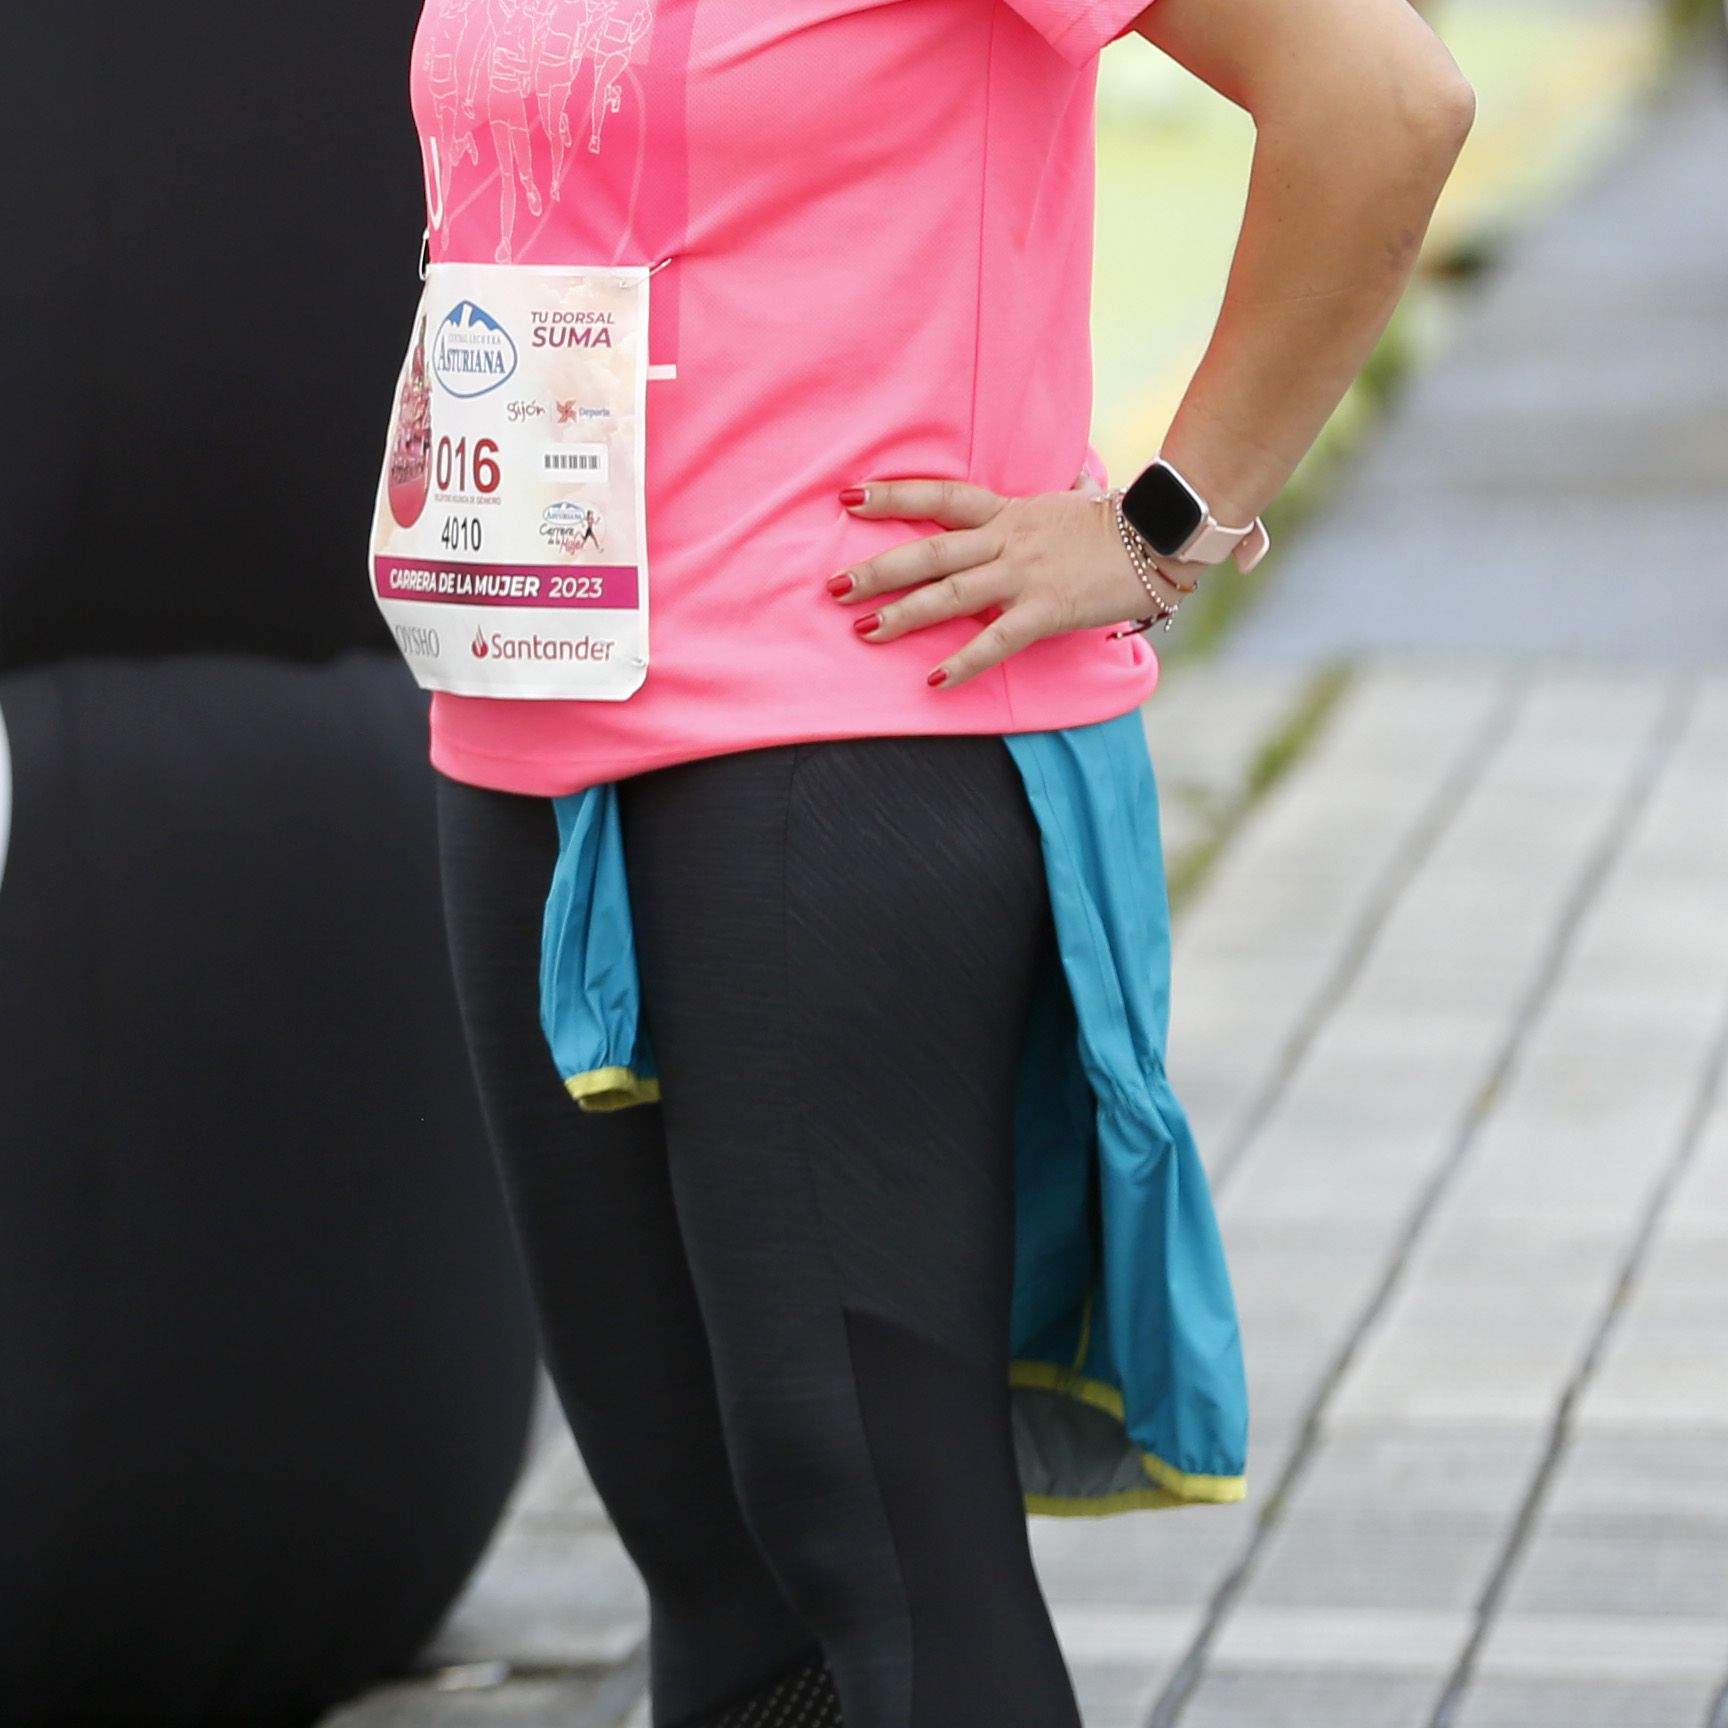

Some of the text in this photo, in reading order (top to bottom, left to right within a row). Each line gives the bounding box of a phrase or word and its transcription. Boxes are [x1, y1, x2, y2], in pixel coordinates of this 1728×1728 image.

[531, 311, 615, 325] TU DORSAL
[531, 325, 612, 349] SUMA
[506, 400, 546, 422] gijón
[436, 435, 501, 494] 016
[442, 516, 482, 552] 4010
[389, 568, 604, 598] CARRERA DE LA MUJER 2023
[492, 632, 615, 661] Santander
